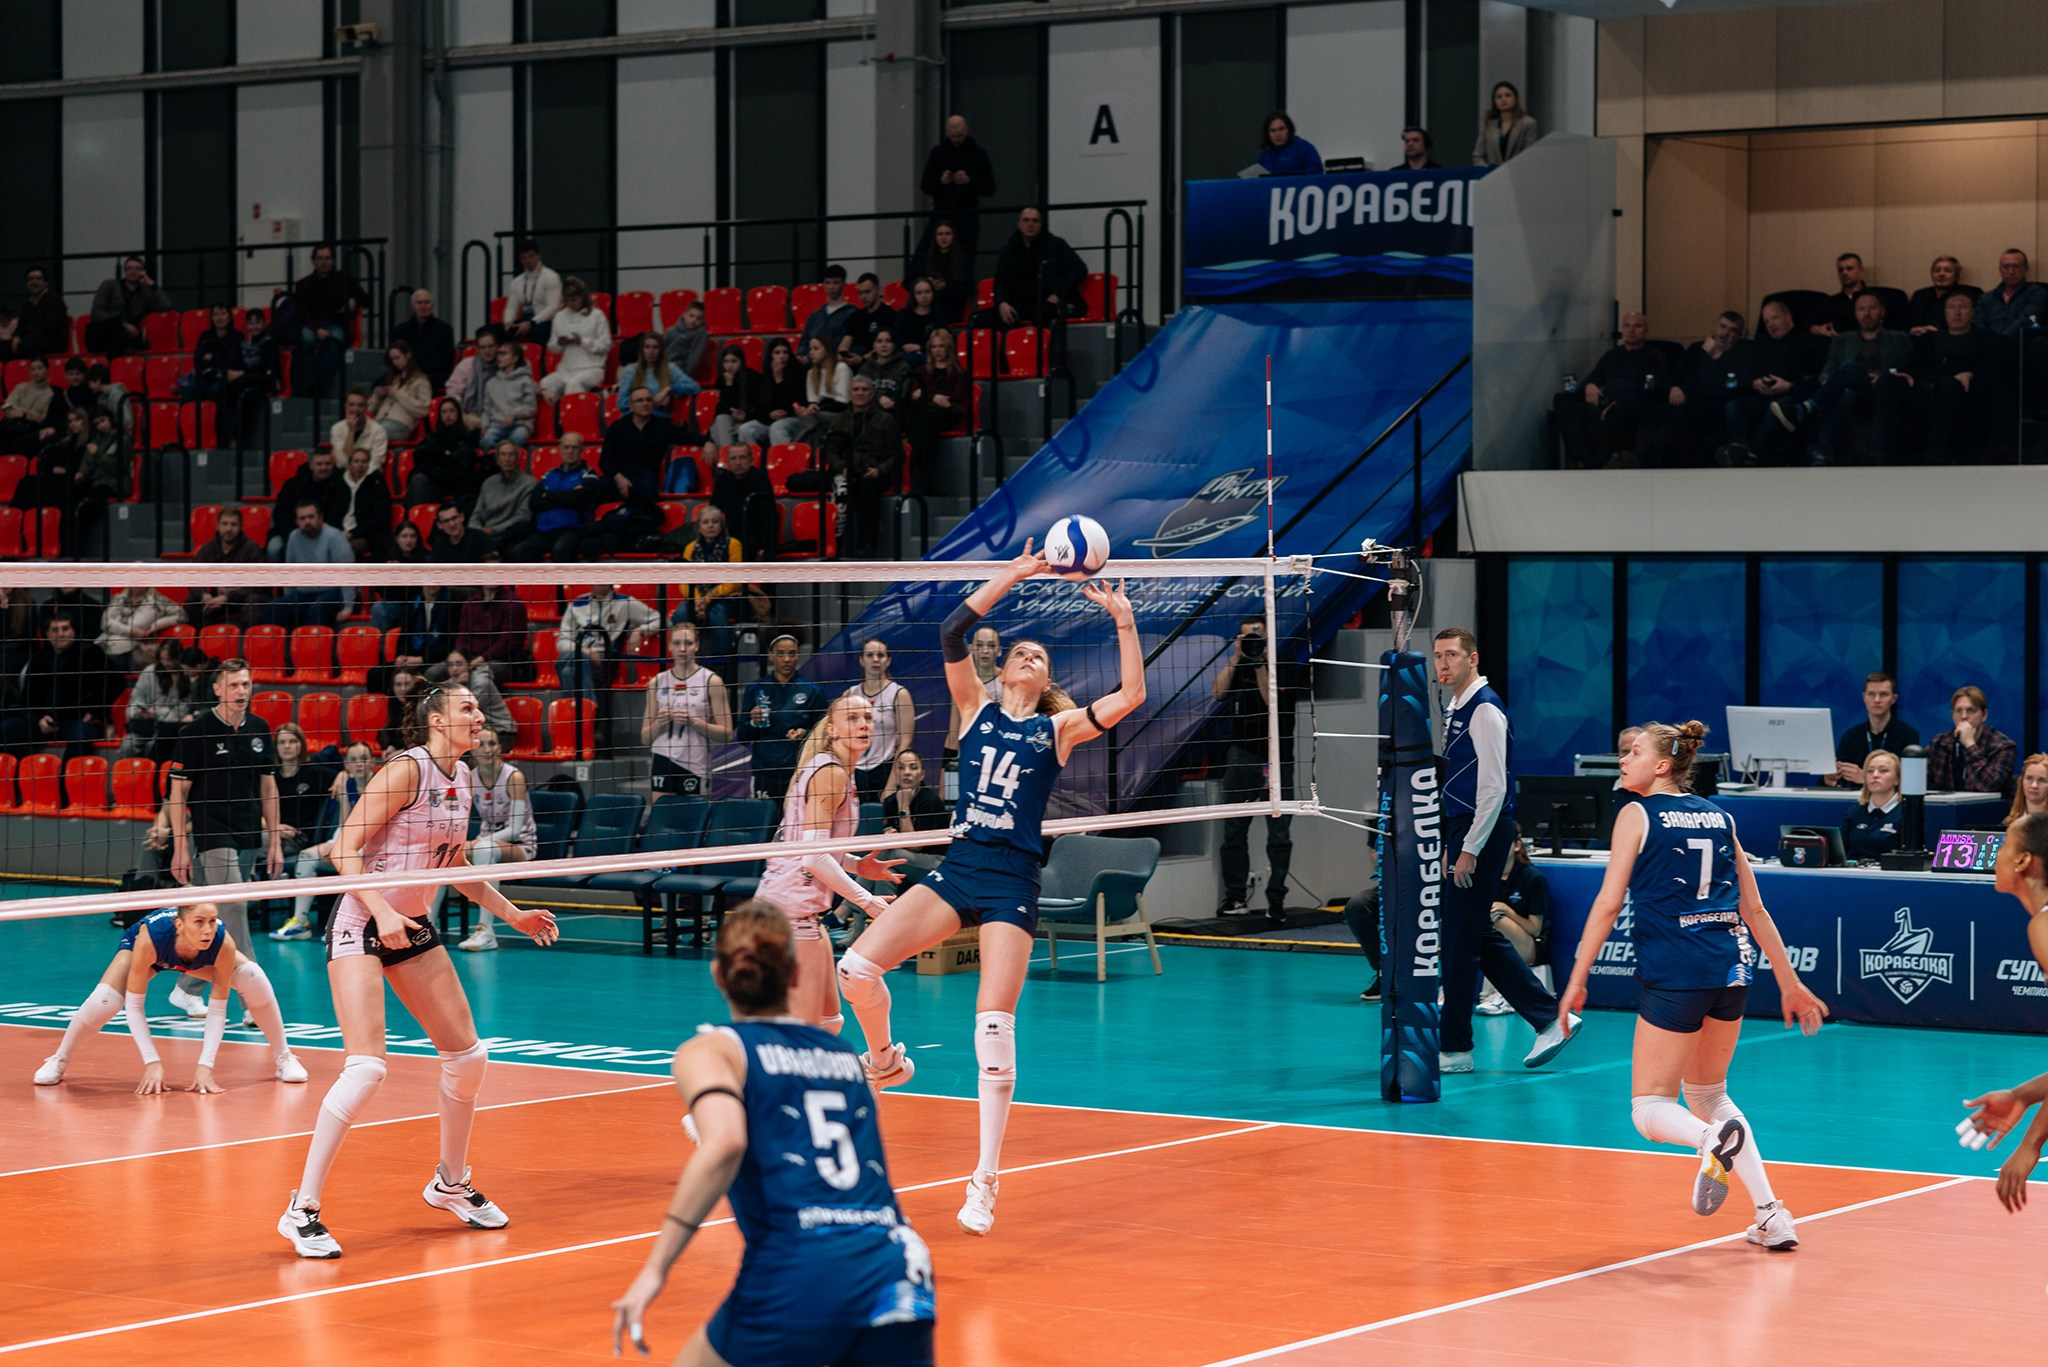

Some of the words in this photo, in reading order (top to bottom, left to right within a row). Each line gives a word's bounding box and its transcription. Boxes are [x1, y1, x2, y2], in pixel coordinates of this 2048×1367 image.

[1089, 104, 1119, 145] A
[977, 745, 1021, 799] 14
[1658, 811, 1728, 830] ЗАХАРОВА
[1410, 766, 1441, 977] КОРАБЕЛКА
[1686, 838, 1714, 900] 7
[1941, 844, 1973, 868] 13
[1865, 954, 1948, 977] КОРАБЕЛКА
[803, 1090, 860, 1190] 5
